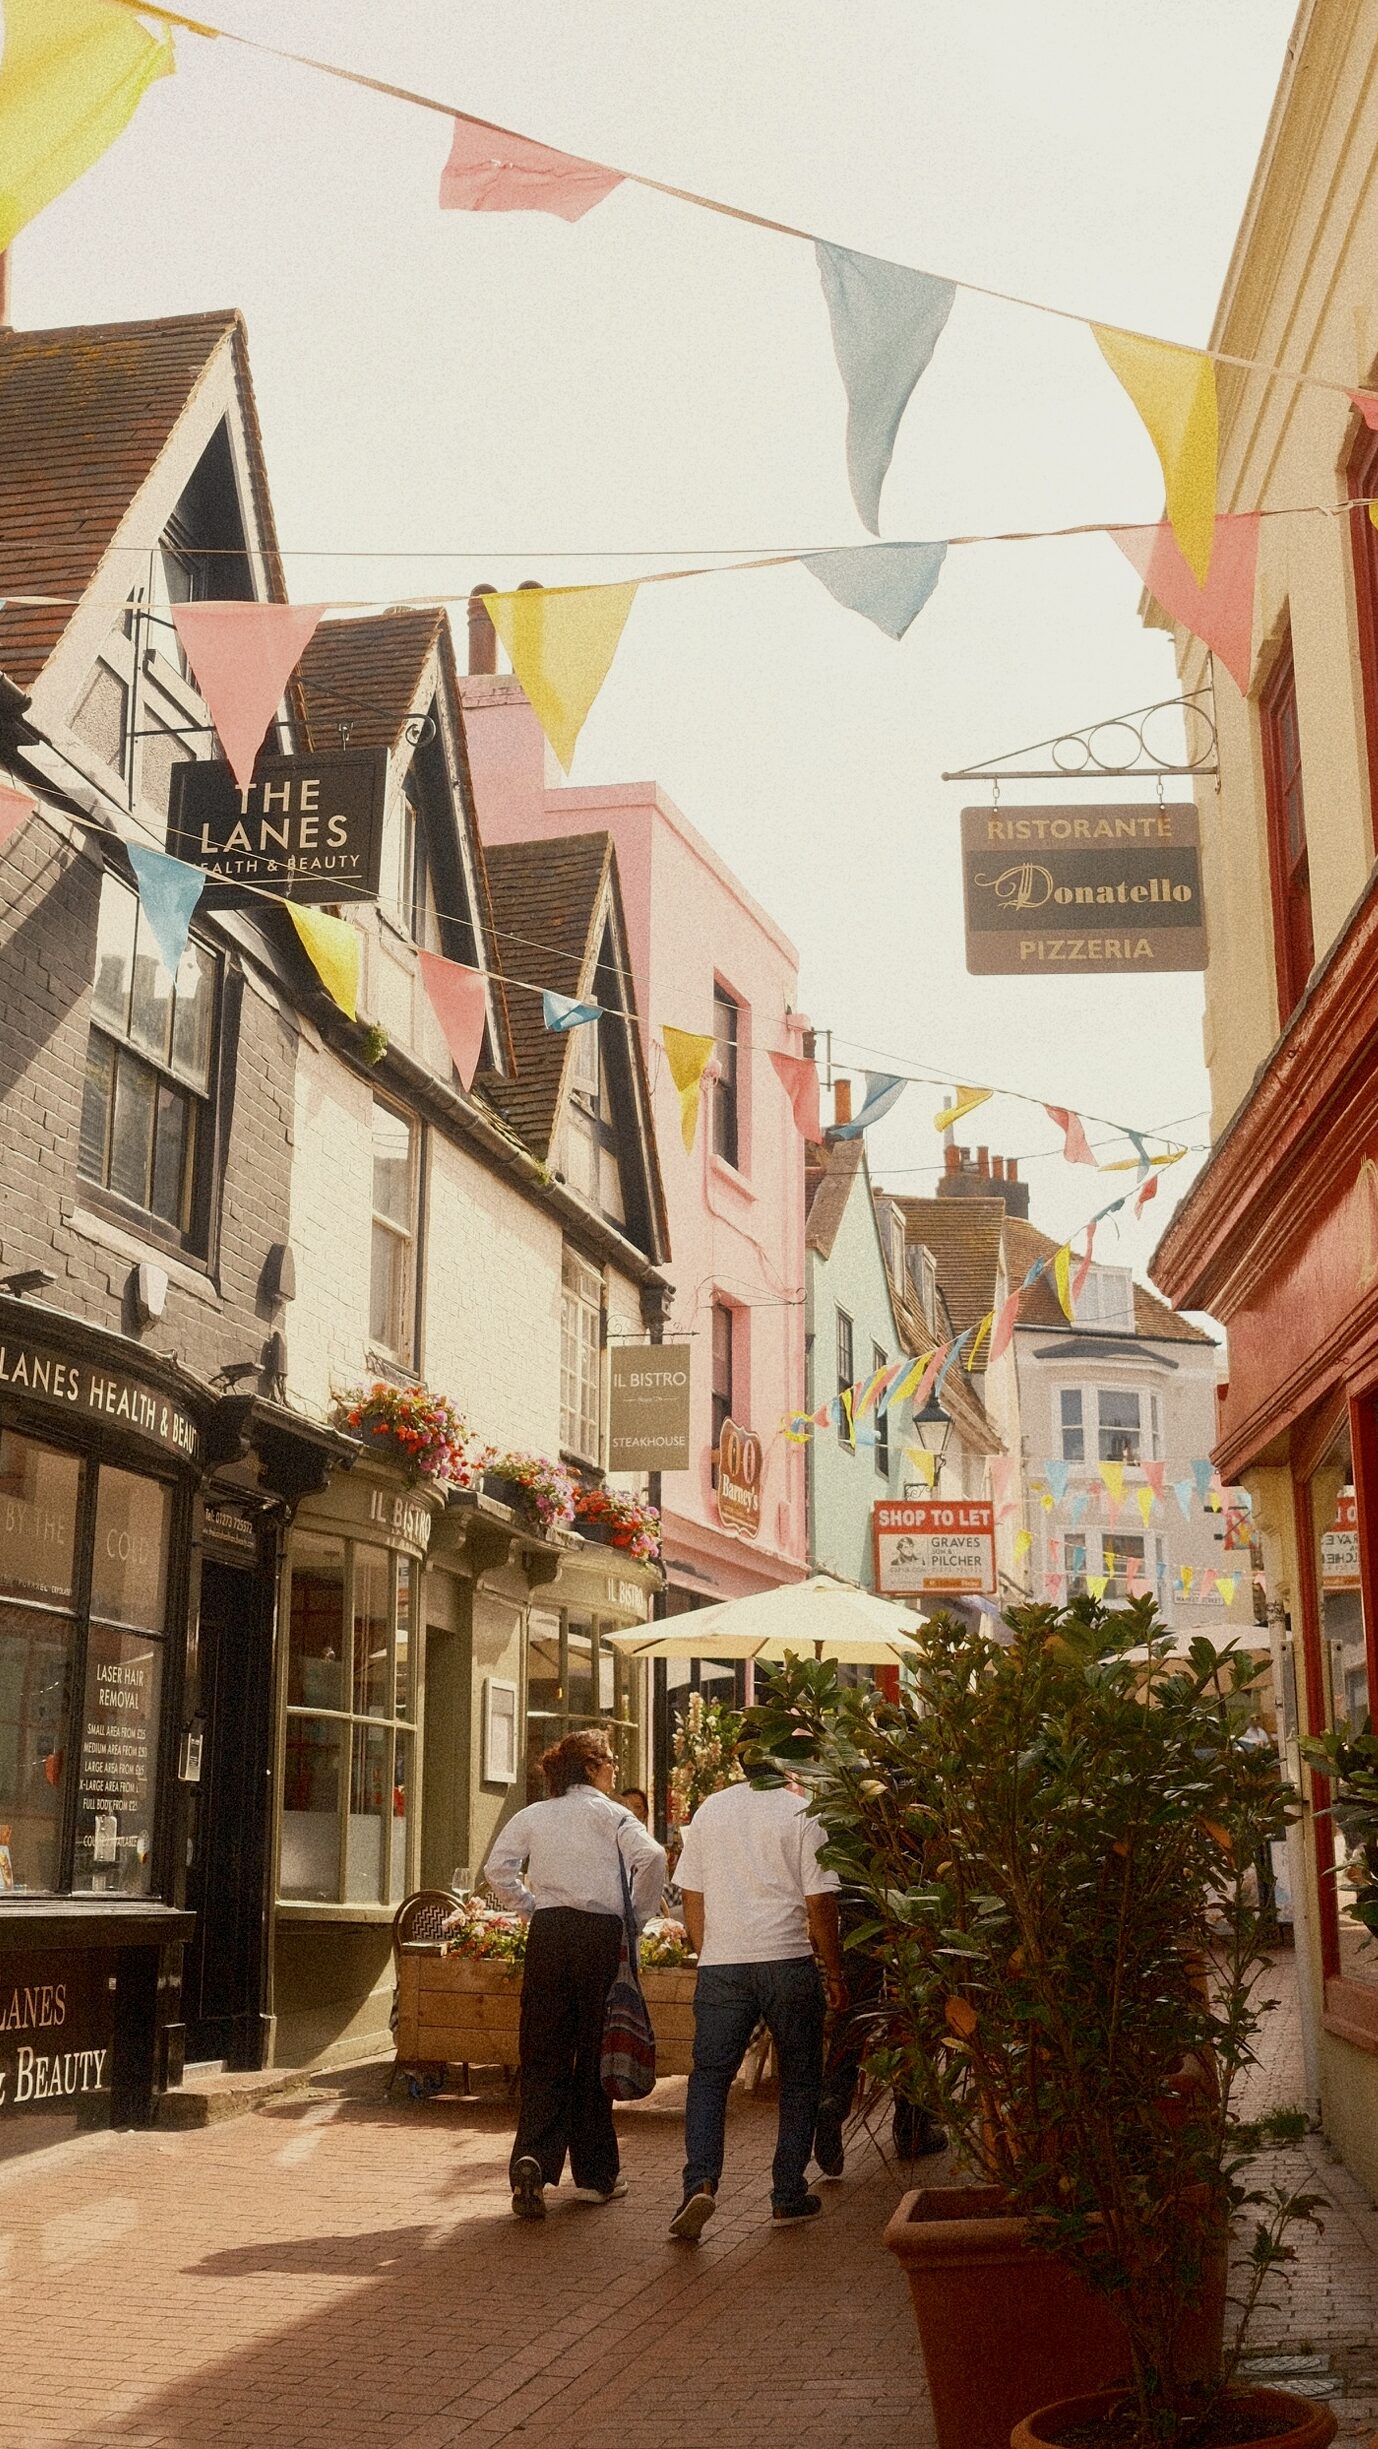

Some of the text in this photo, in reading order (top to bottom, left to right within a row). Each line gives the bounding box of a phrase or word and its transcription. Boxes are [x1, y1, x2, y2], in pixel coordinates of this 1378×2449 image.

[235, 779, 320, 814] THE
[200, 815, 348, 854] LANES
[987, 818, 1173, 840] RISTORANTE
[192, 855, 360, 874] EALTH & BEAUTY
[974, 863, 1192, 911] Donatello
[1019, 938, 1154, 960] PIZZERIA
[614, 1371, 687, 1388] IL BISTRO
[0, 1346, 79, 1401] LANES
[90, 1376, 156, 1431] HEALTH
[160, 1407, 168, 1438] &
[613, 1436, 686, 1448] STEAKHOUSE
[722, 1473, 758, 1513] Barney's
[371, 1490, 431, 1541] IL BISTRO
[879, 1509, 990, 1526] SHOP TO LET
[931, 1536, 980, 1548] GRAVES
[931, 1556, 982, 1566] PILCHER
[608, 1578, 617, 1602] IL
[97, 1664, 144, 1687] LASER HAIR
[99, 1688, 139, 1710] REMOVAL
[87, 1723, 105, 1736] SMALL
[106, 1726, 120, 1737] AREA
[121, 1726, 136, 1738] FROM
[83, 1742, 107, 1754] MEDIUM
[107, 1744, 121, 1755] AREA
[122, 1745, 137, 1756] FROM
[84, 1761, 104, 1773] LARGE
[104, 1762, 118, 1774] AREA
[119, 1763, 134, 1775] FROM
[104, 1780, 119, 1792] AREA
[120, 1781, 135, 1793] FROM
[83, 1798, 96, 1810] FULL
[113, 1800, 128, 1811] FROM
